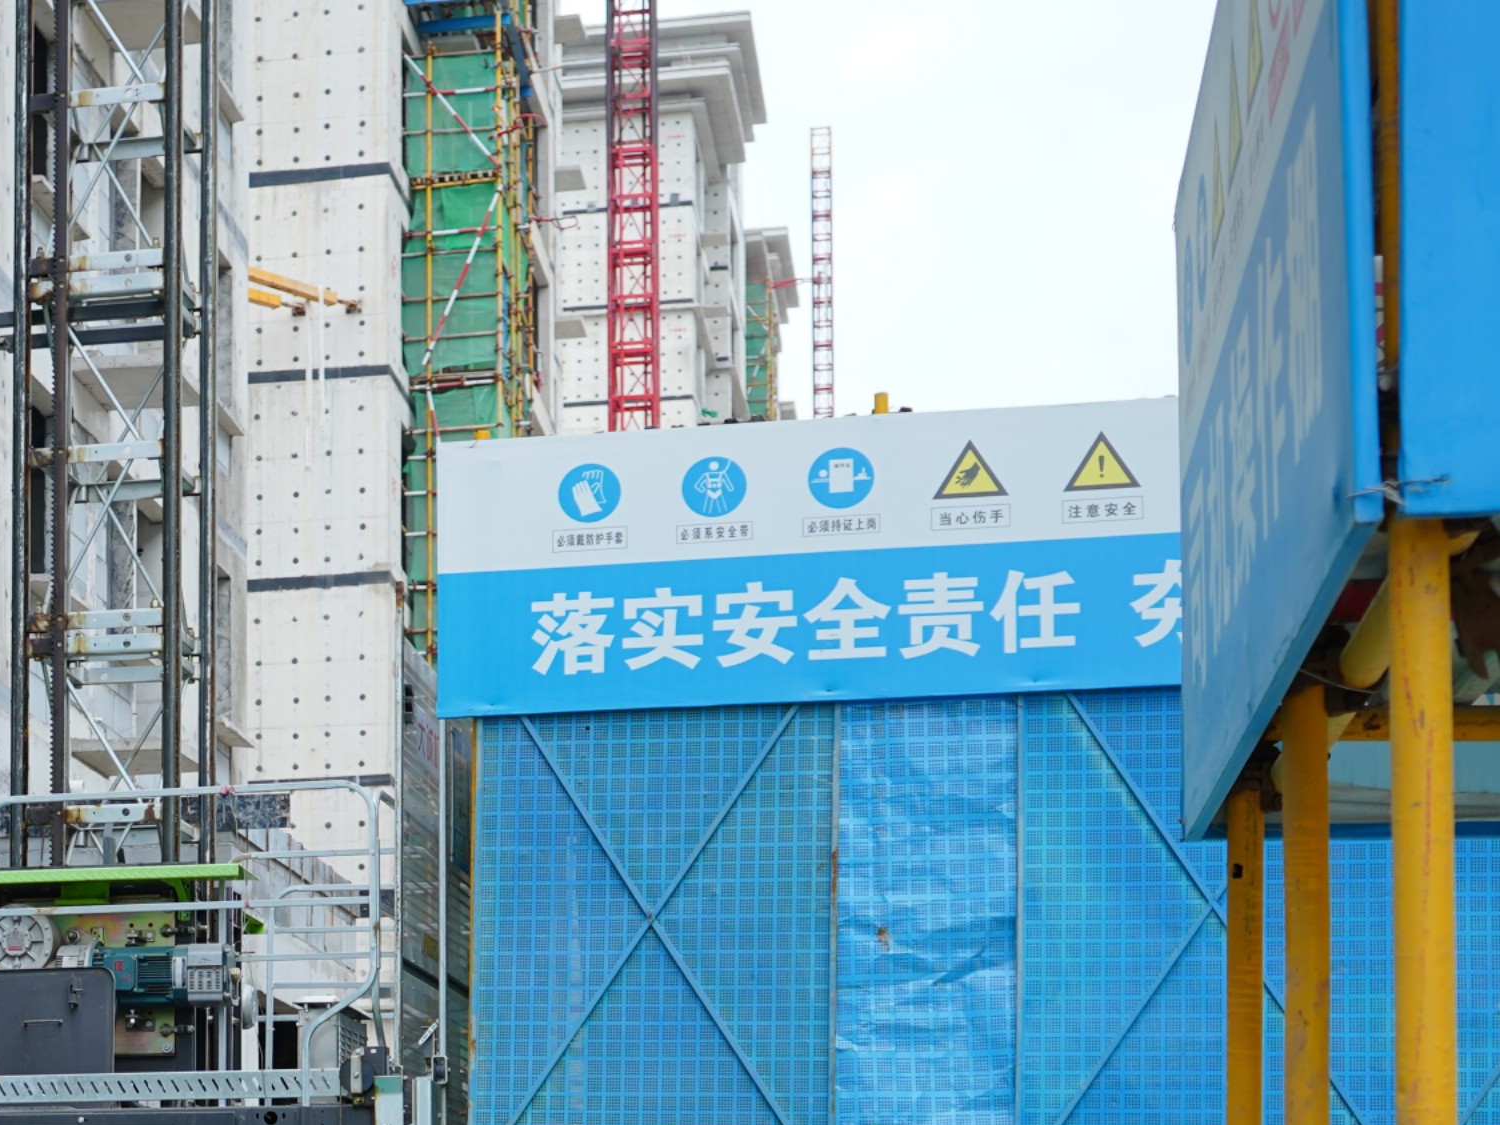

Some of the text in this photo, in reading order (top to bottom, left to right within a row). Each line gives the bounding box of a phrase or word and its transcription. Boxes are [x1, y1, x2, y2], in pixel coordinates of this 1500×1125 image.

[1188, 102, 1323, 687] 司机操作棚
[1068, 501, 1137, 518] 注意安全
[807, 518, 876, 534] 必须持证上岗
[939, 510, 1004, 526] 当心伤手
[557, 532, 624, 548] 必须戴防护手套
[681, 525, 749, 541] 必须系安全带
[531, 569, 1081, 675] 落实安全责任
